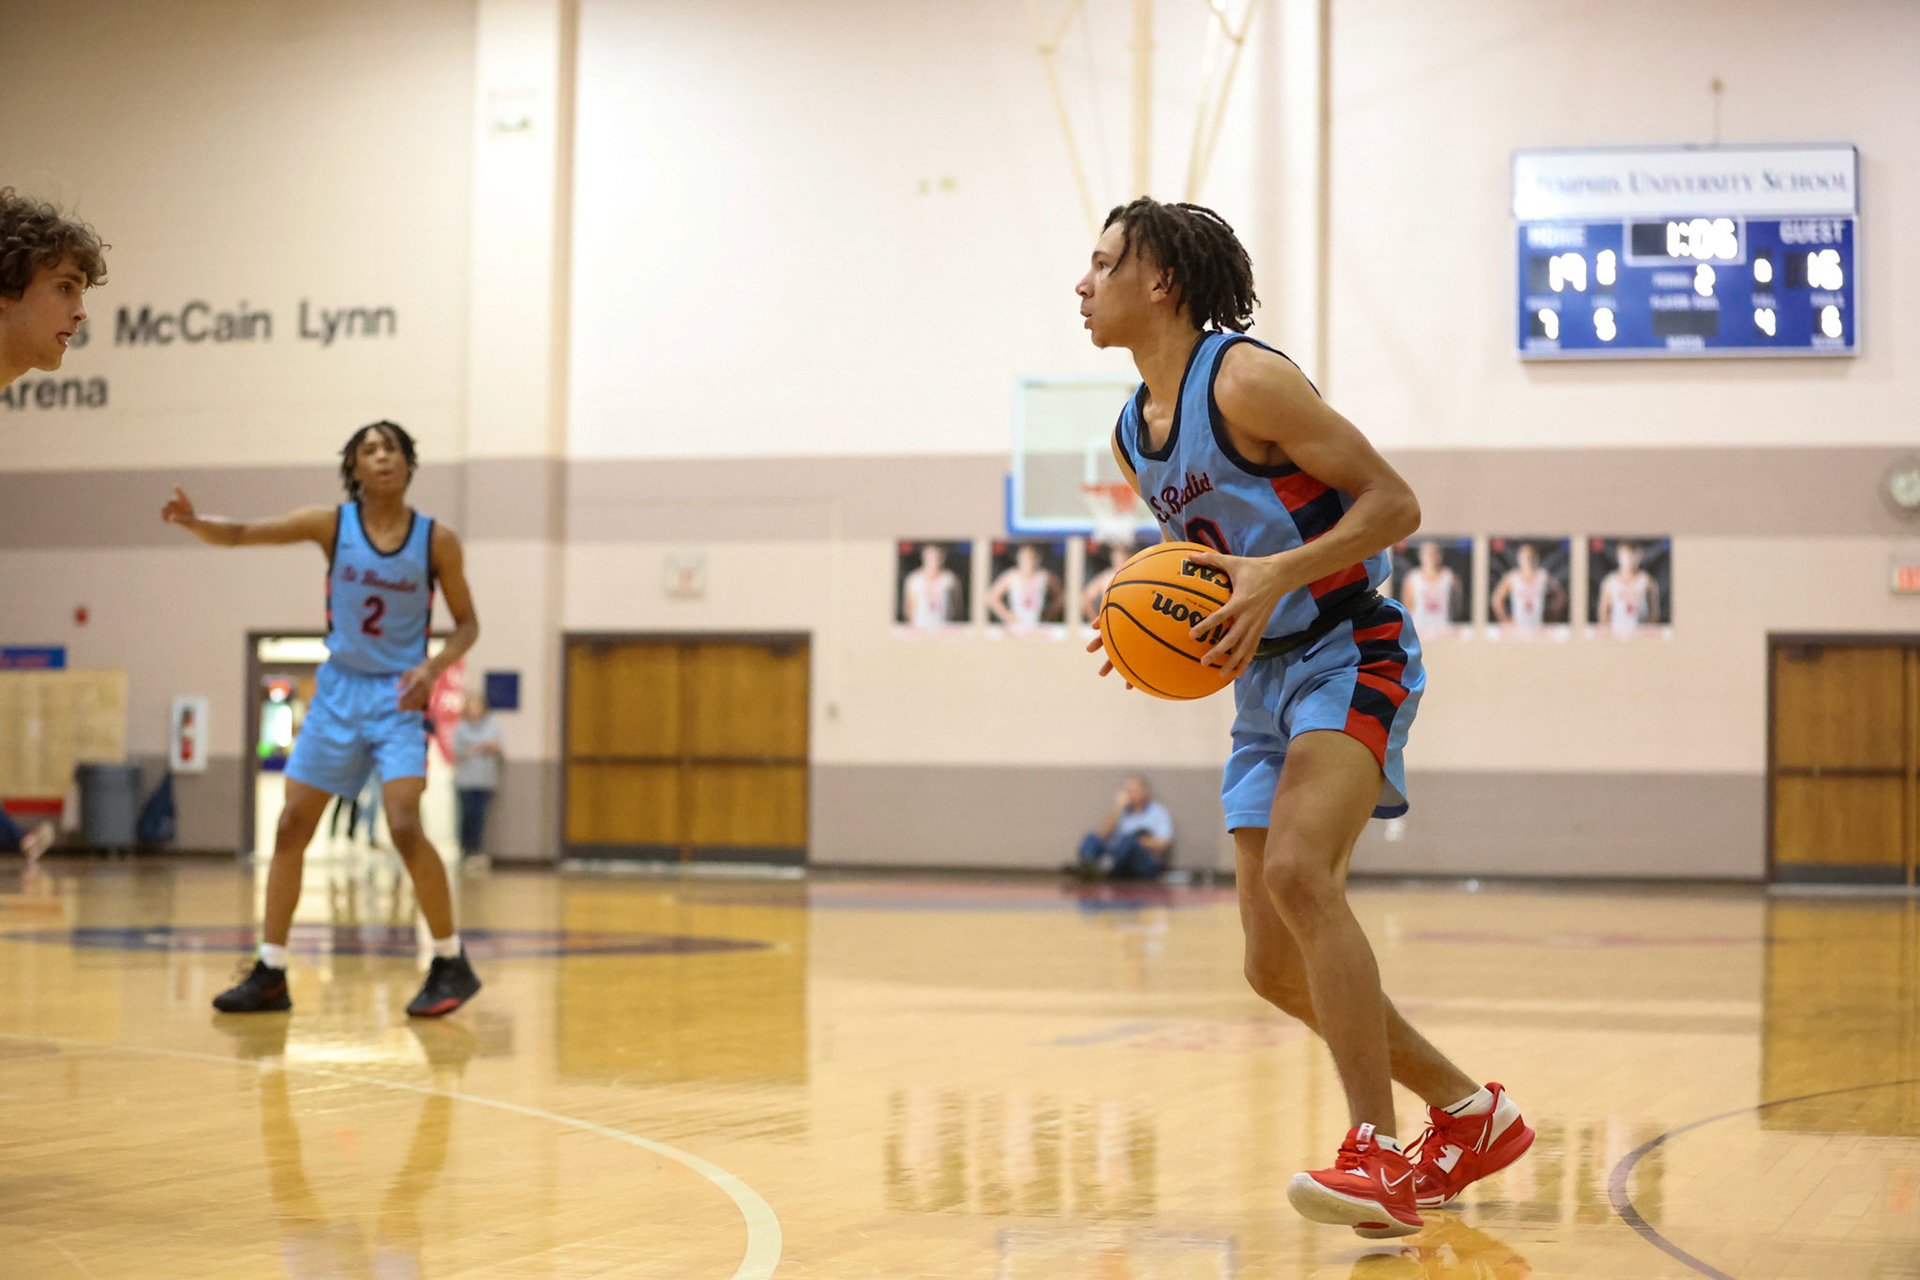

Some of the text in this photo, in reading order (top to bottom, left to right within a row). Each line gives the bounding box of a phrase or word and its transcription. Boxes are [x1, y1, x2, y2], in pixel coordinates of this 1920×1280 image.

[115, 300, 273, 347] McCain
[300, 300, 396, 348] Lynn
[1181, 558, 1233, 594] CAA
[361, 594, 386, 638] 2
